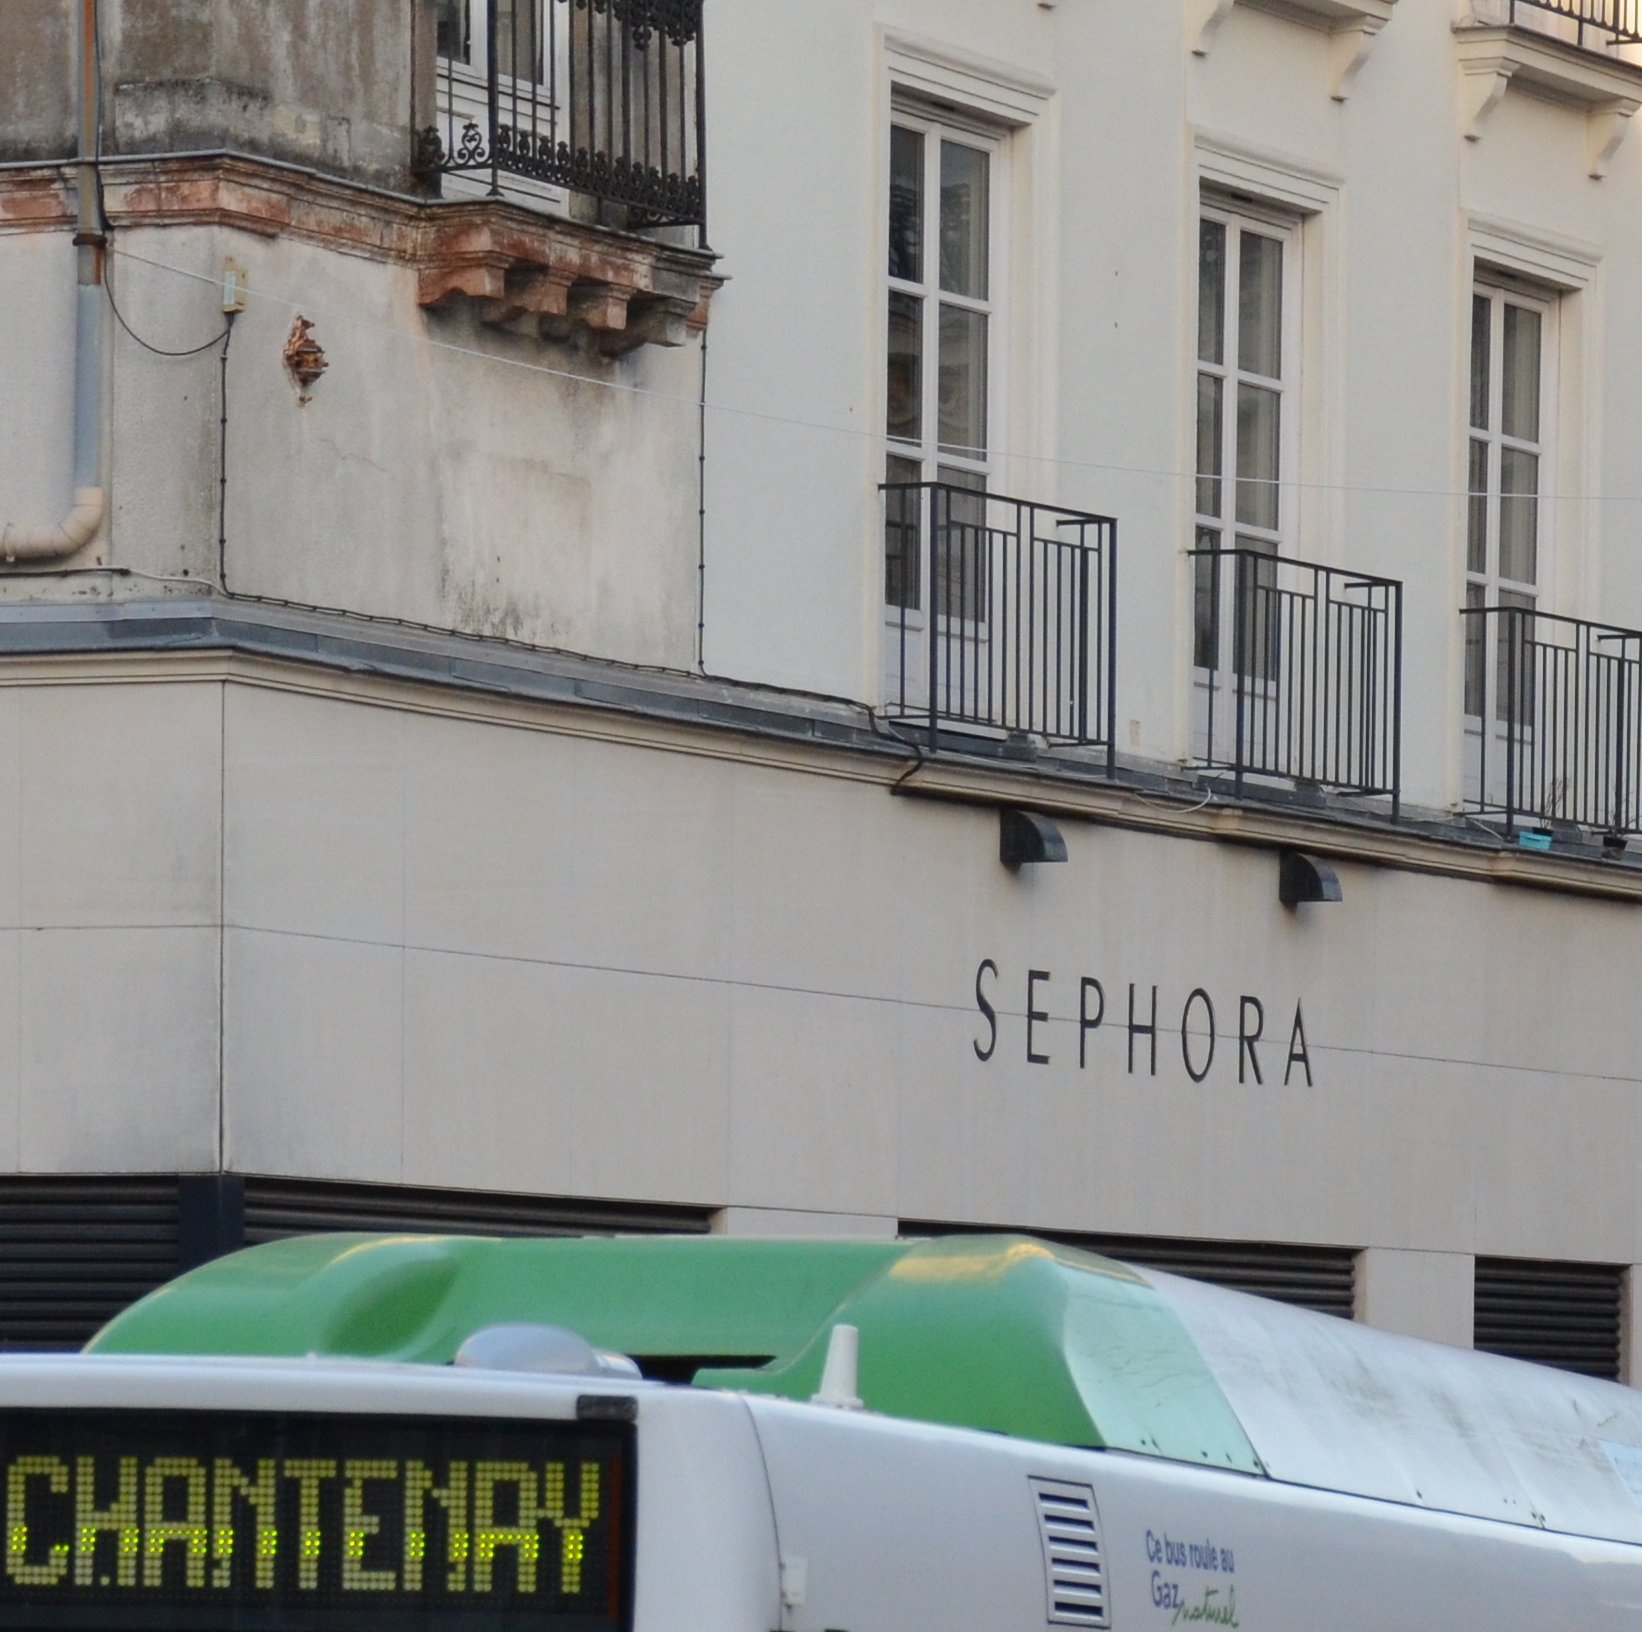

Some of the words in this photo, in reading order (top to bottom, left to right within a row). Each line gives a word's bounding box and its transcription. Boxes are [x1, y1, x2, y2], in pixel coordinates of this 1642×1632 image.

[973, 958, 1314, 1088] SEPHORA
[5, 1454, 603, 1597] CHANTENAY
[1146, 1529, 1163, 1563] Ce
[1164, 1533, 1187, 1567] bus
[1189, 1539, 1218, 1571] roule
[1220, 1548, 1235, 1573] au
[1151, 1570, 1180, 1609] Gaz
[1172, 1584, 1240, 1629] naturel
